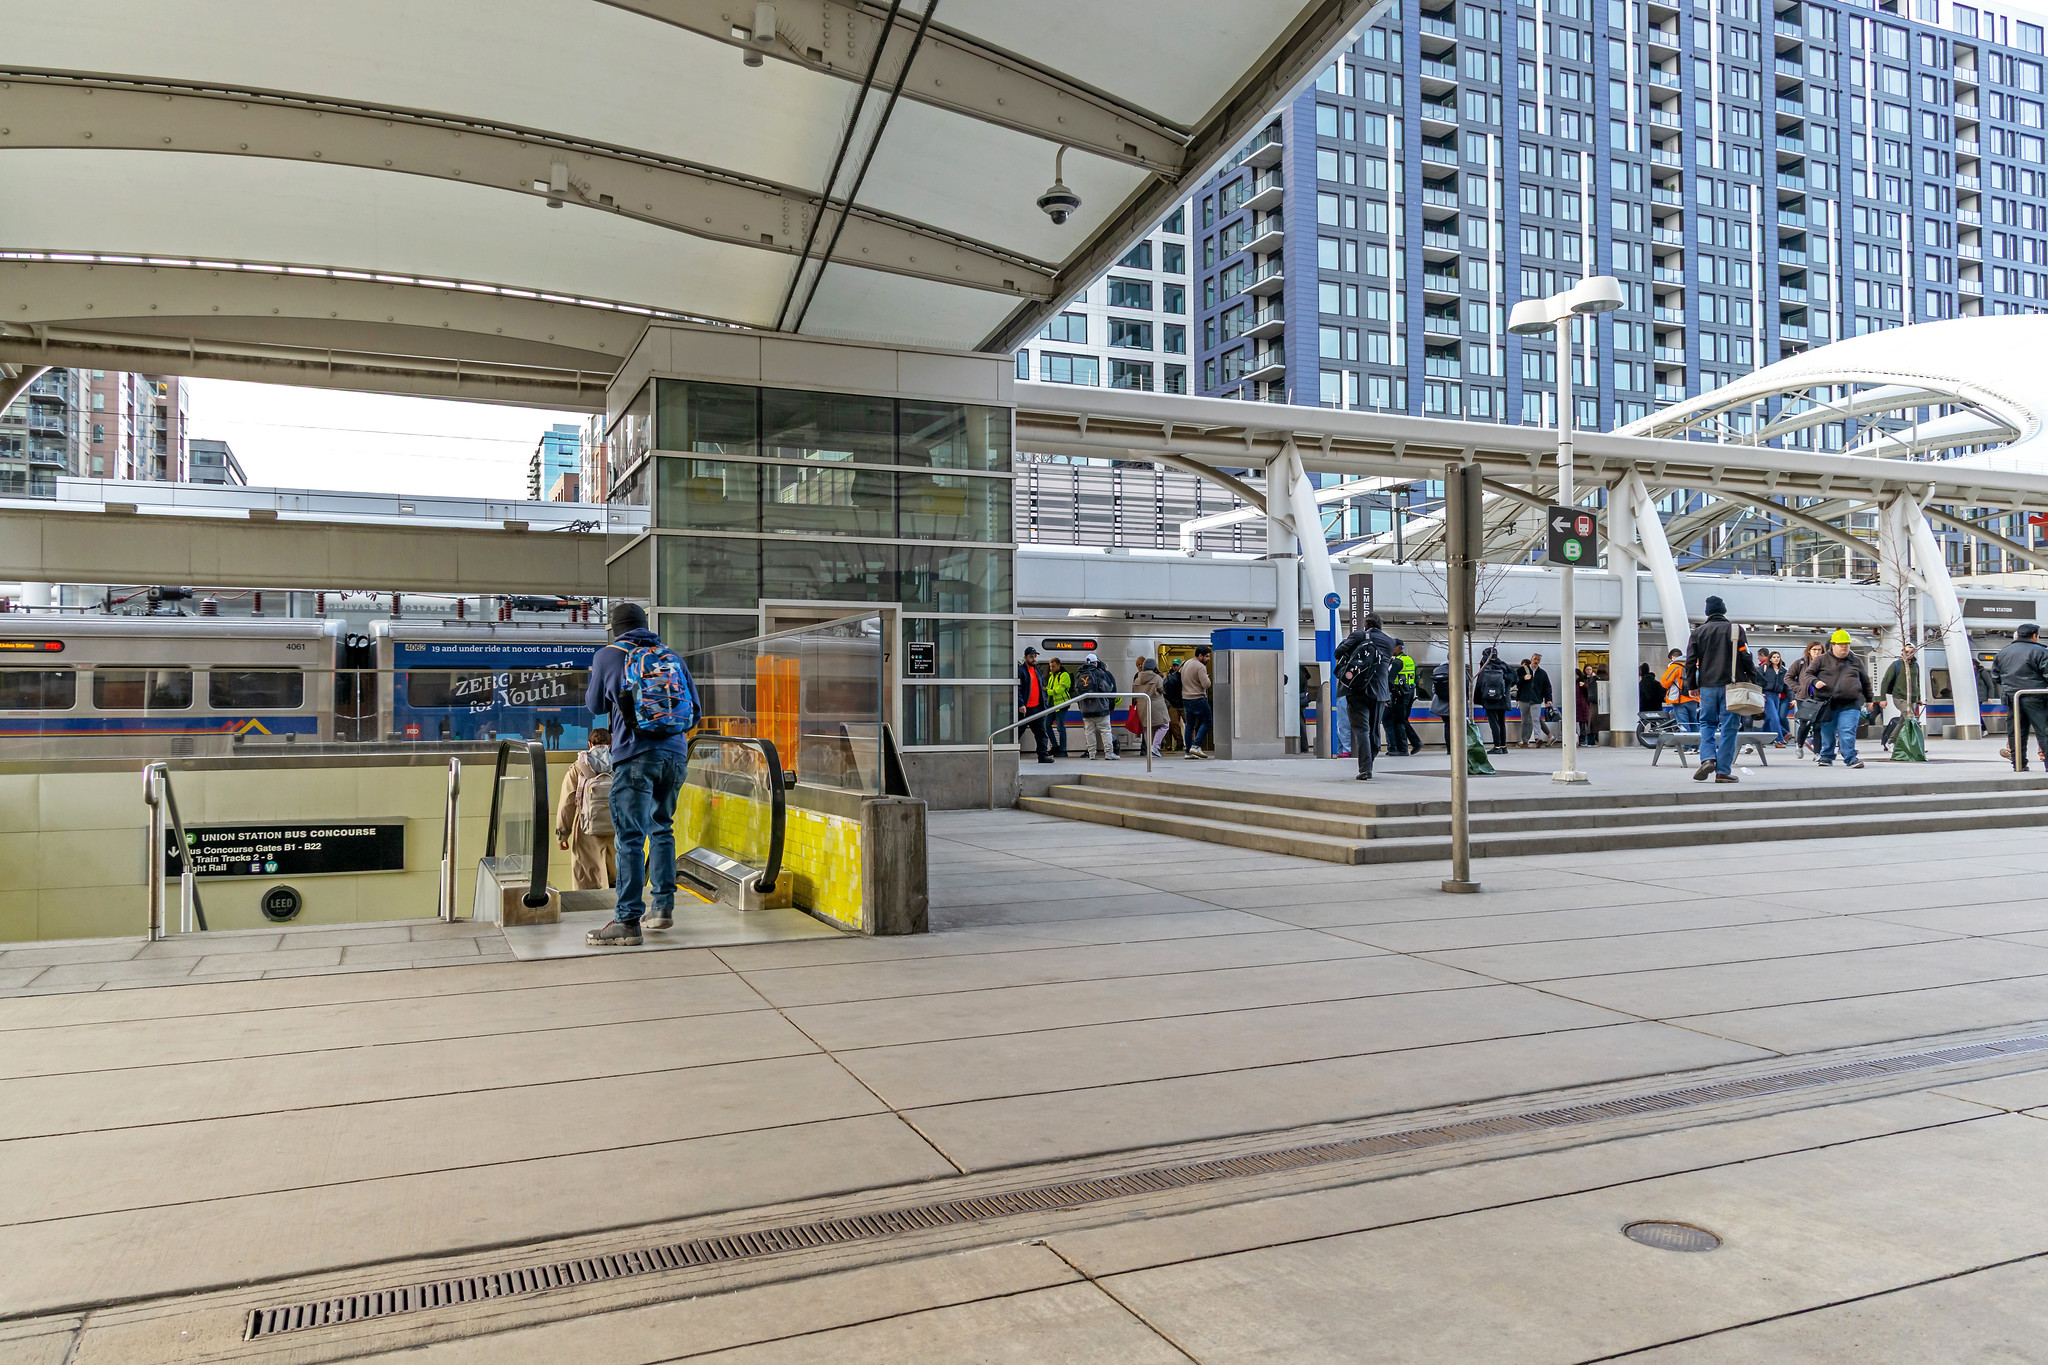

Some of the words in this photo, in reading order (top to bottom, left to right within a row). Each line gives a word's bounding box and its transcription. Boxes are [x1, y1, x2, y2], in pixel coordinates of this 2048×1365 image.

[1565, 542, 1581, 558] B
[286, 643, 305, 651] 4061
[883, 653, 891, 663] 7
[455, 672, 513, 697] ZERO
[469, 700, 495, 714] for
[499, 680, 567, 708] Youth
[202, 833, 235, 842] UNION
[238, 831, 282, 841] STATION
[285, 830, 307, 839] BUS
[310, 828, 377, 838] CONCOURSE
[203, 845, 254, 854] Concourse
[255, 844, 282, 852] Gates
[284, 843, 296, 851] B1
[304, 842, 322, 851] B22
[196, 855, 219, 863] Train
[221, 854, 251, 863] Tracks
[253, 853, 260, 861] 2
[208, 864, 227, 872] Rail
[251, 864, 260, 873] E
[265, 864, 278, 873] W
[270, 898, 293, 909] LEED
